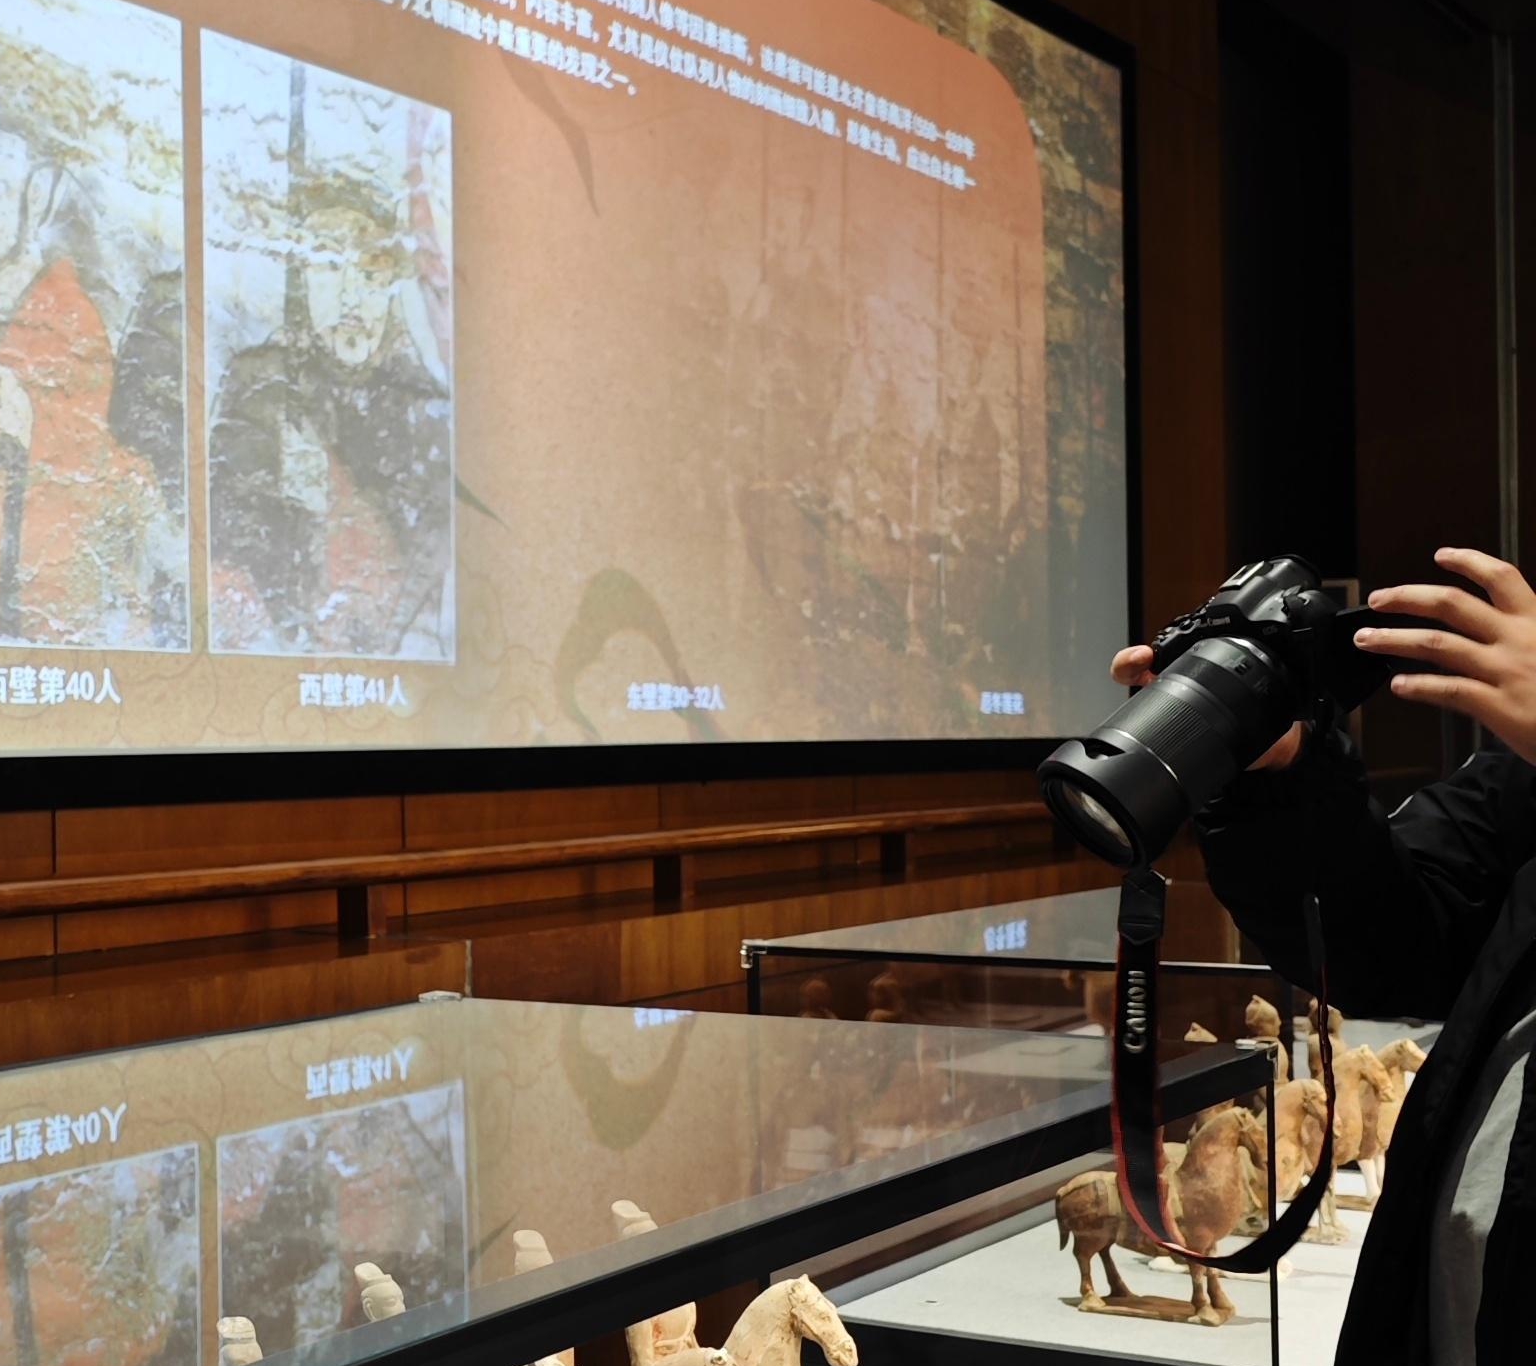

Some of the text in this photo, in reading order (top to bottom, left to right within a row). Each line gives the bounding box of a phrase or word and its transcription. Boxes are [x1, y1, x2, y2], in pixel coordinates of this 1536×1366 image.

[298, 671, 409, 707] 西壁第41人
[1124, 970, 1146, 1053] Canon
